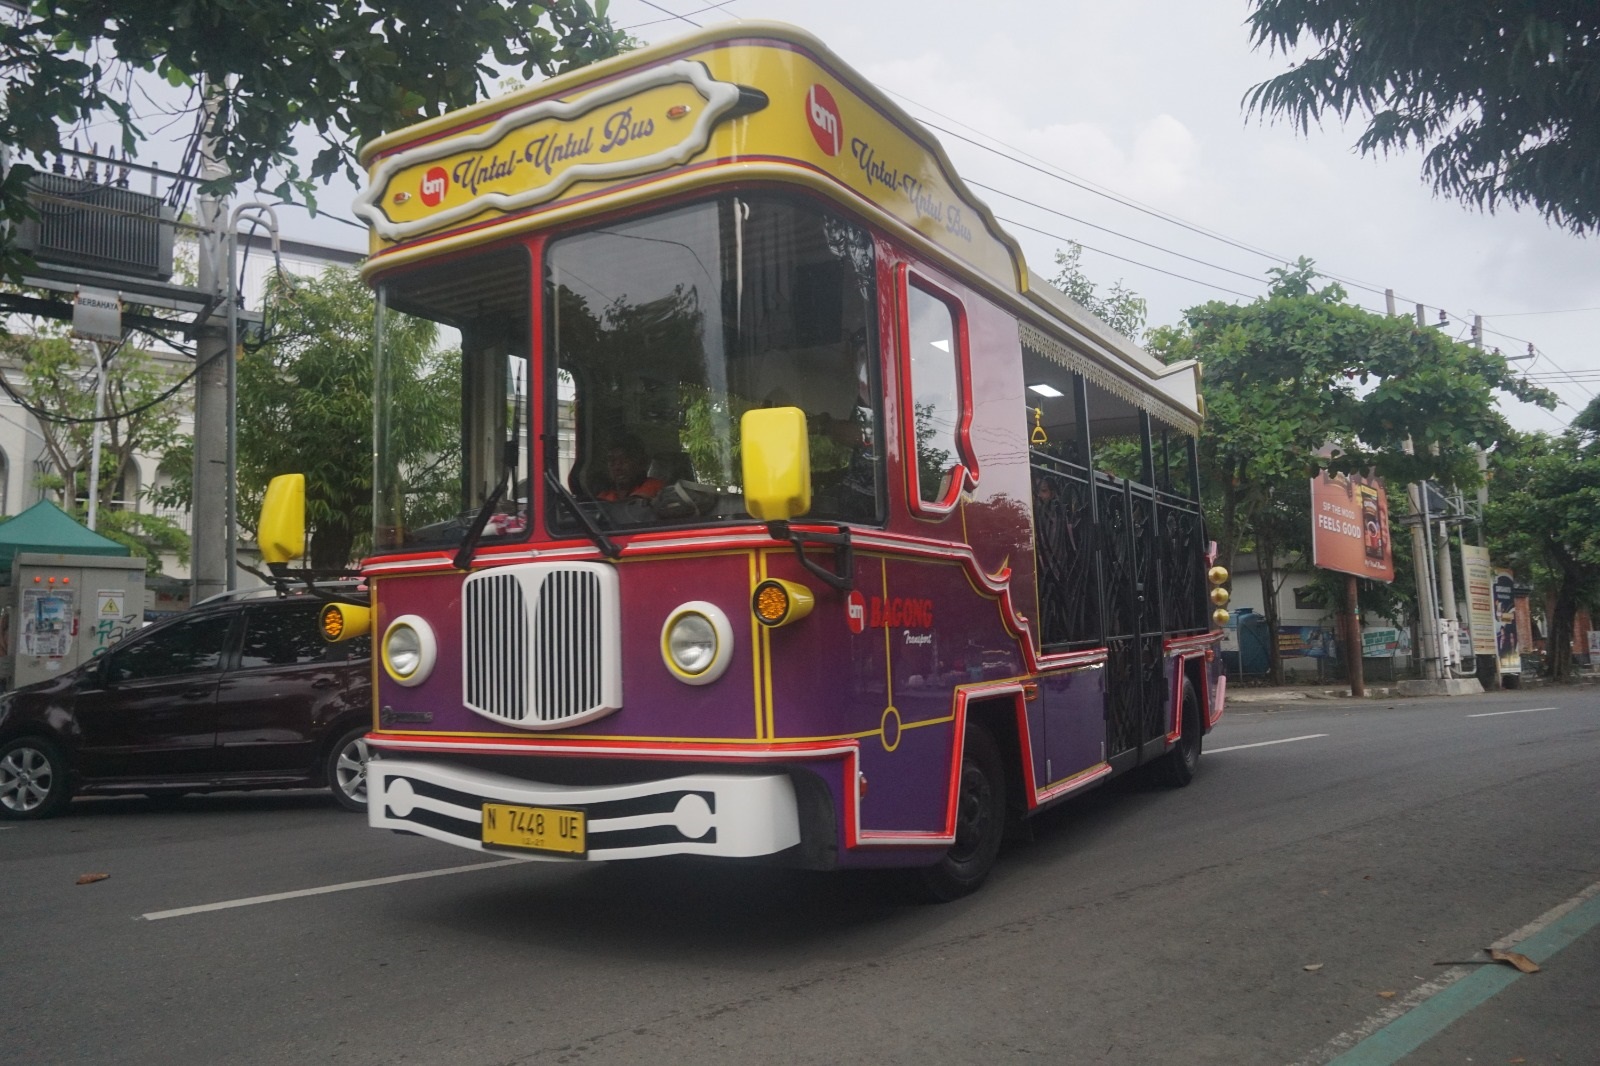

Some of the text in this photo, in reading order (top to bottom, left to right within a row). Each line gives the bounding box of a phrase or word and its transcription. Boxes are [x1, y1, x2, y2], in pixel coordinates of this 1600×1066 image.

[452, 106, 655, 196] Untal-Untul Bus
[851, 137, 973, 243] Untal-Untul Bus
[77, 297, 119, 311] BERBAHAYA
[1322, 501, 1356, 520] SIP THE MOOD
[1318, 514, 1361, 539] FEELS GOOD
[870, 596, 934, 628] BAGONG
[903, 629, 932, 647] Transport
[487, 807, 578, 839] N 7448 UE
